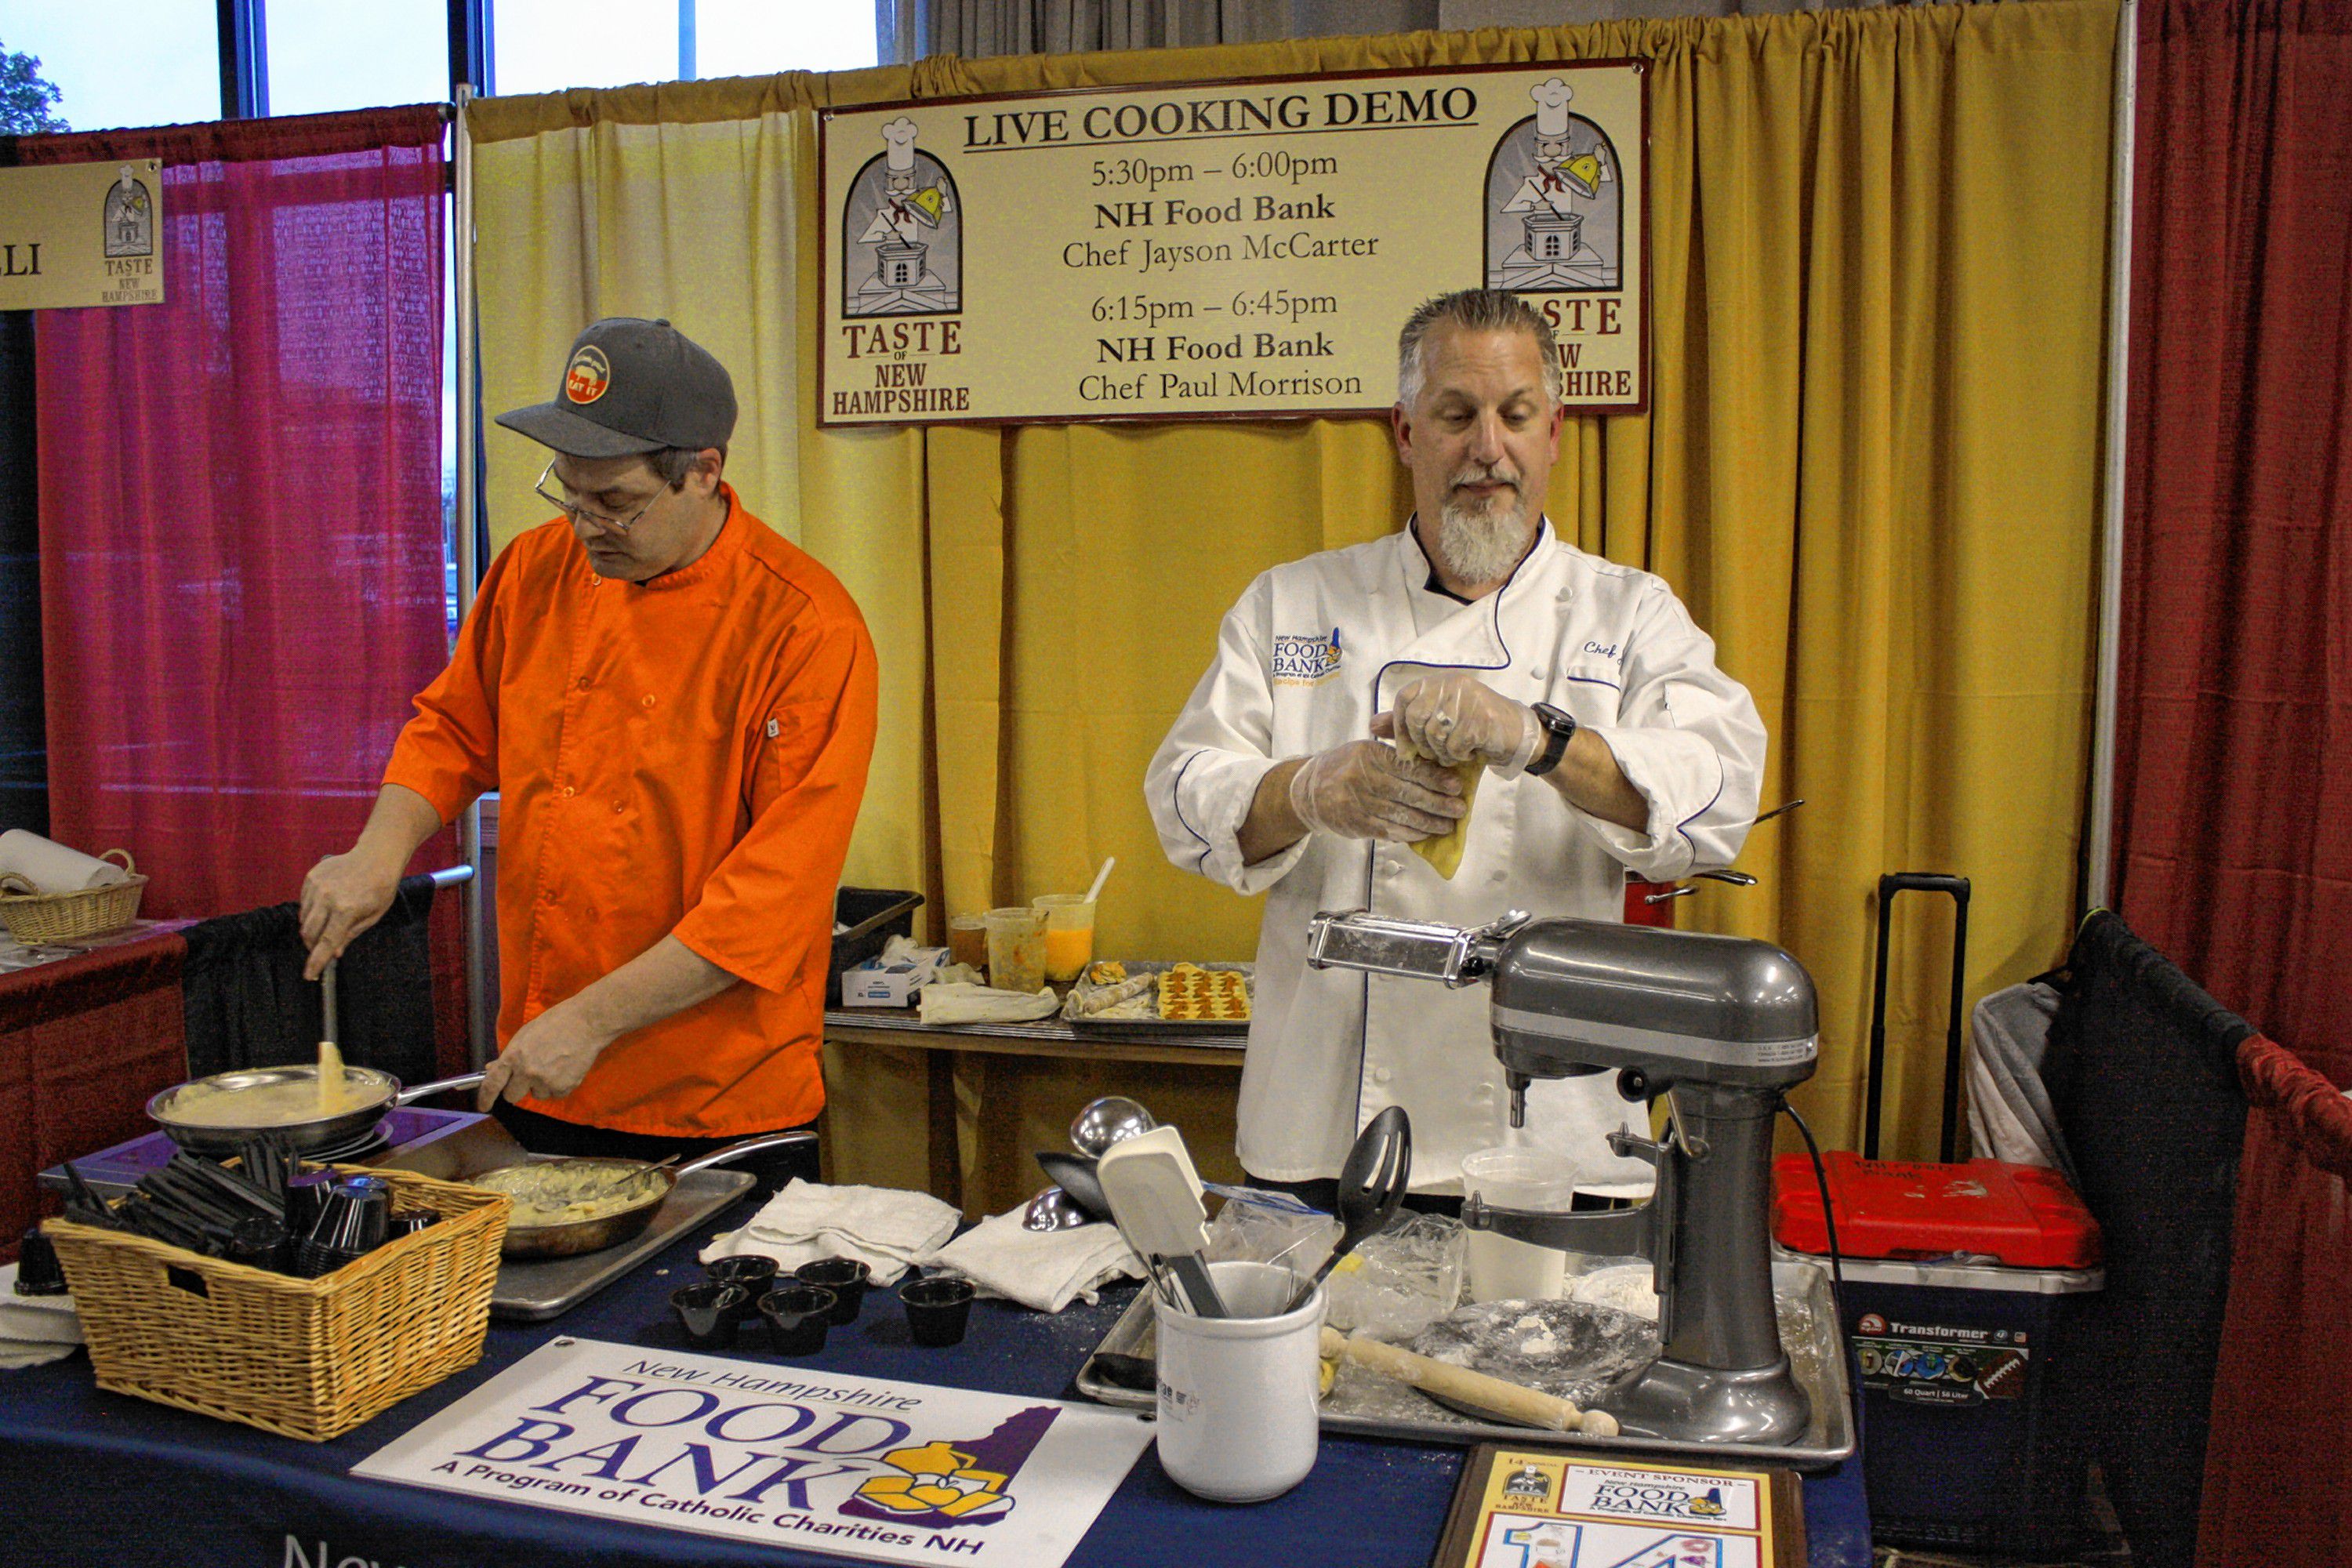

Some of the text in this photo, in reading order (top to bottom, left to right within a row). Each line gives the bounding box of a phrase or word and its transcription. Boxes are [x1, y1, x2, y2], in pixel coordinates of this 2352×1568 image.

[964, 86, 1477, 147] LIVE COOKING DEMO
[1092, 158, 1194, 193] 5:30pm
[1232, 151, 1338, 184] 6:00pm
[1094, 193, 1336, 229] NH Food Bank
[0, 243, 42, 277] LI
[1063, 233, 1379, 274] Chef Jayson McCarter
[105, 258, 153, 277] TASTE
[102, 289, 158, 303] HAMPSHIRE
[119, 278, 140, 289] NEW
[1091, 294, 1193, 329] 6:15pm
[1232, 288, 1338, 323] 6:45pm
[1521, 298, 1622, 336] STE
[842, 320, 962, 359] TASTE
[1097, 332, 1334, 364] NH Food Bank
[893, 350, 908, 361] OF
[875, 363, 927, 389] NEW
[1079, 369, 1362, 403] Chef Paul Morrison
[832, 387, 971, 416] HAMPSHIRE
[1273, 642, 1328, 658] FOOD
[1584, 641, 1617, 659] Chef
[1272, 657, 1326, 673] BANK
[1889, 1322, 1990, 1340] Transformer
[622, 1359, 923, 1410] New Hampshire
[1914, 1389, 1936, 1398] Quart
[528, 1374, 911, 1454] FOOD
[454, 1416, 872, 1512] BANK
[1588, 1468, 1733, 1487] EVENT SPONSOR
[1504, 1494, 1548, 1504] TASTE
[1594, 1484, 1690, 1502] FOOD
[1629, 1481, 1686, 1491] Hampshire
[430, 1459, 986, 1556] A Program of Catholic Charities NH
[1590, 1495, 1688, 1516] BANK
